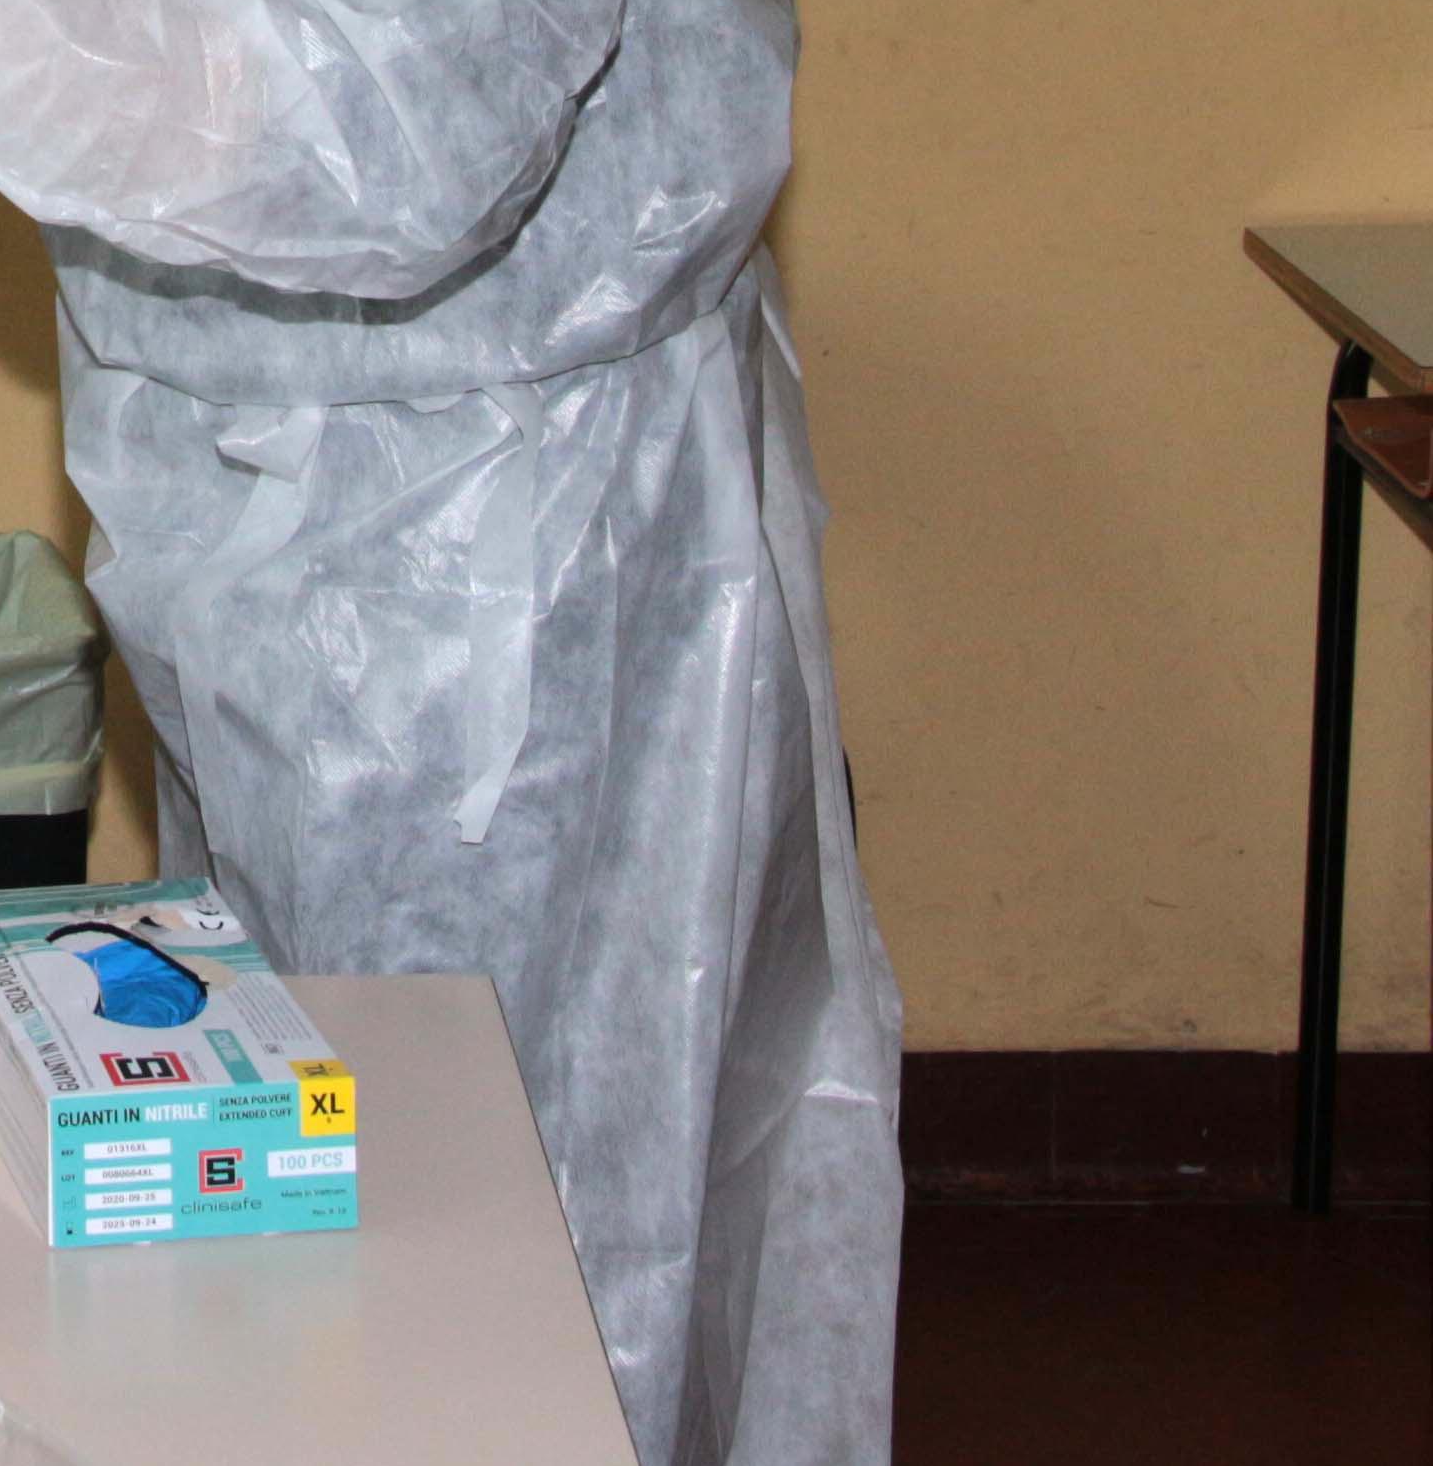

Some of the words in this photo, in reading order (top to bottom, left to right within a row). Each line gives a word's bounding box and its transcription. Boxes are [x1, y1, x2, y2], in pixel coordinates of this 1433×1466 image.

[219, 1096, 249, 1107] SENZA
[251, 1093, 292, 1105] POLVERE
[310, 1092, 345, 1116] XL
[57, 1109, 119, 1128] GUANTI
[124, 1107, 141, 1123] IN
[144, 1102, 209, 1122] NITRILE
[219, 1110, 267, 1122] EXTENDED
[269, 1108, 292, 1119] CUFF
[277, 1153, 307, 1171] 100
[311, 1151, 344, 1168] PCS
[180, 1196, 263, 1216] clinisafe
